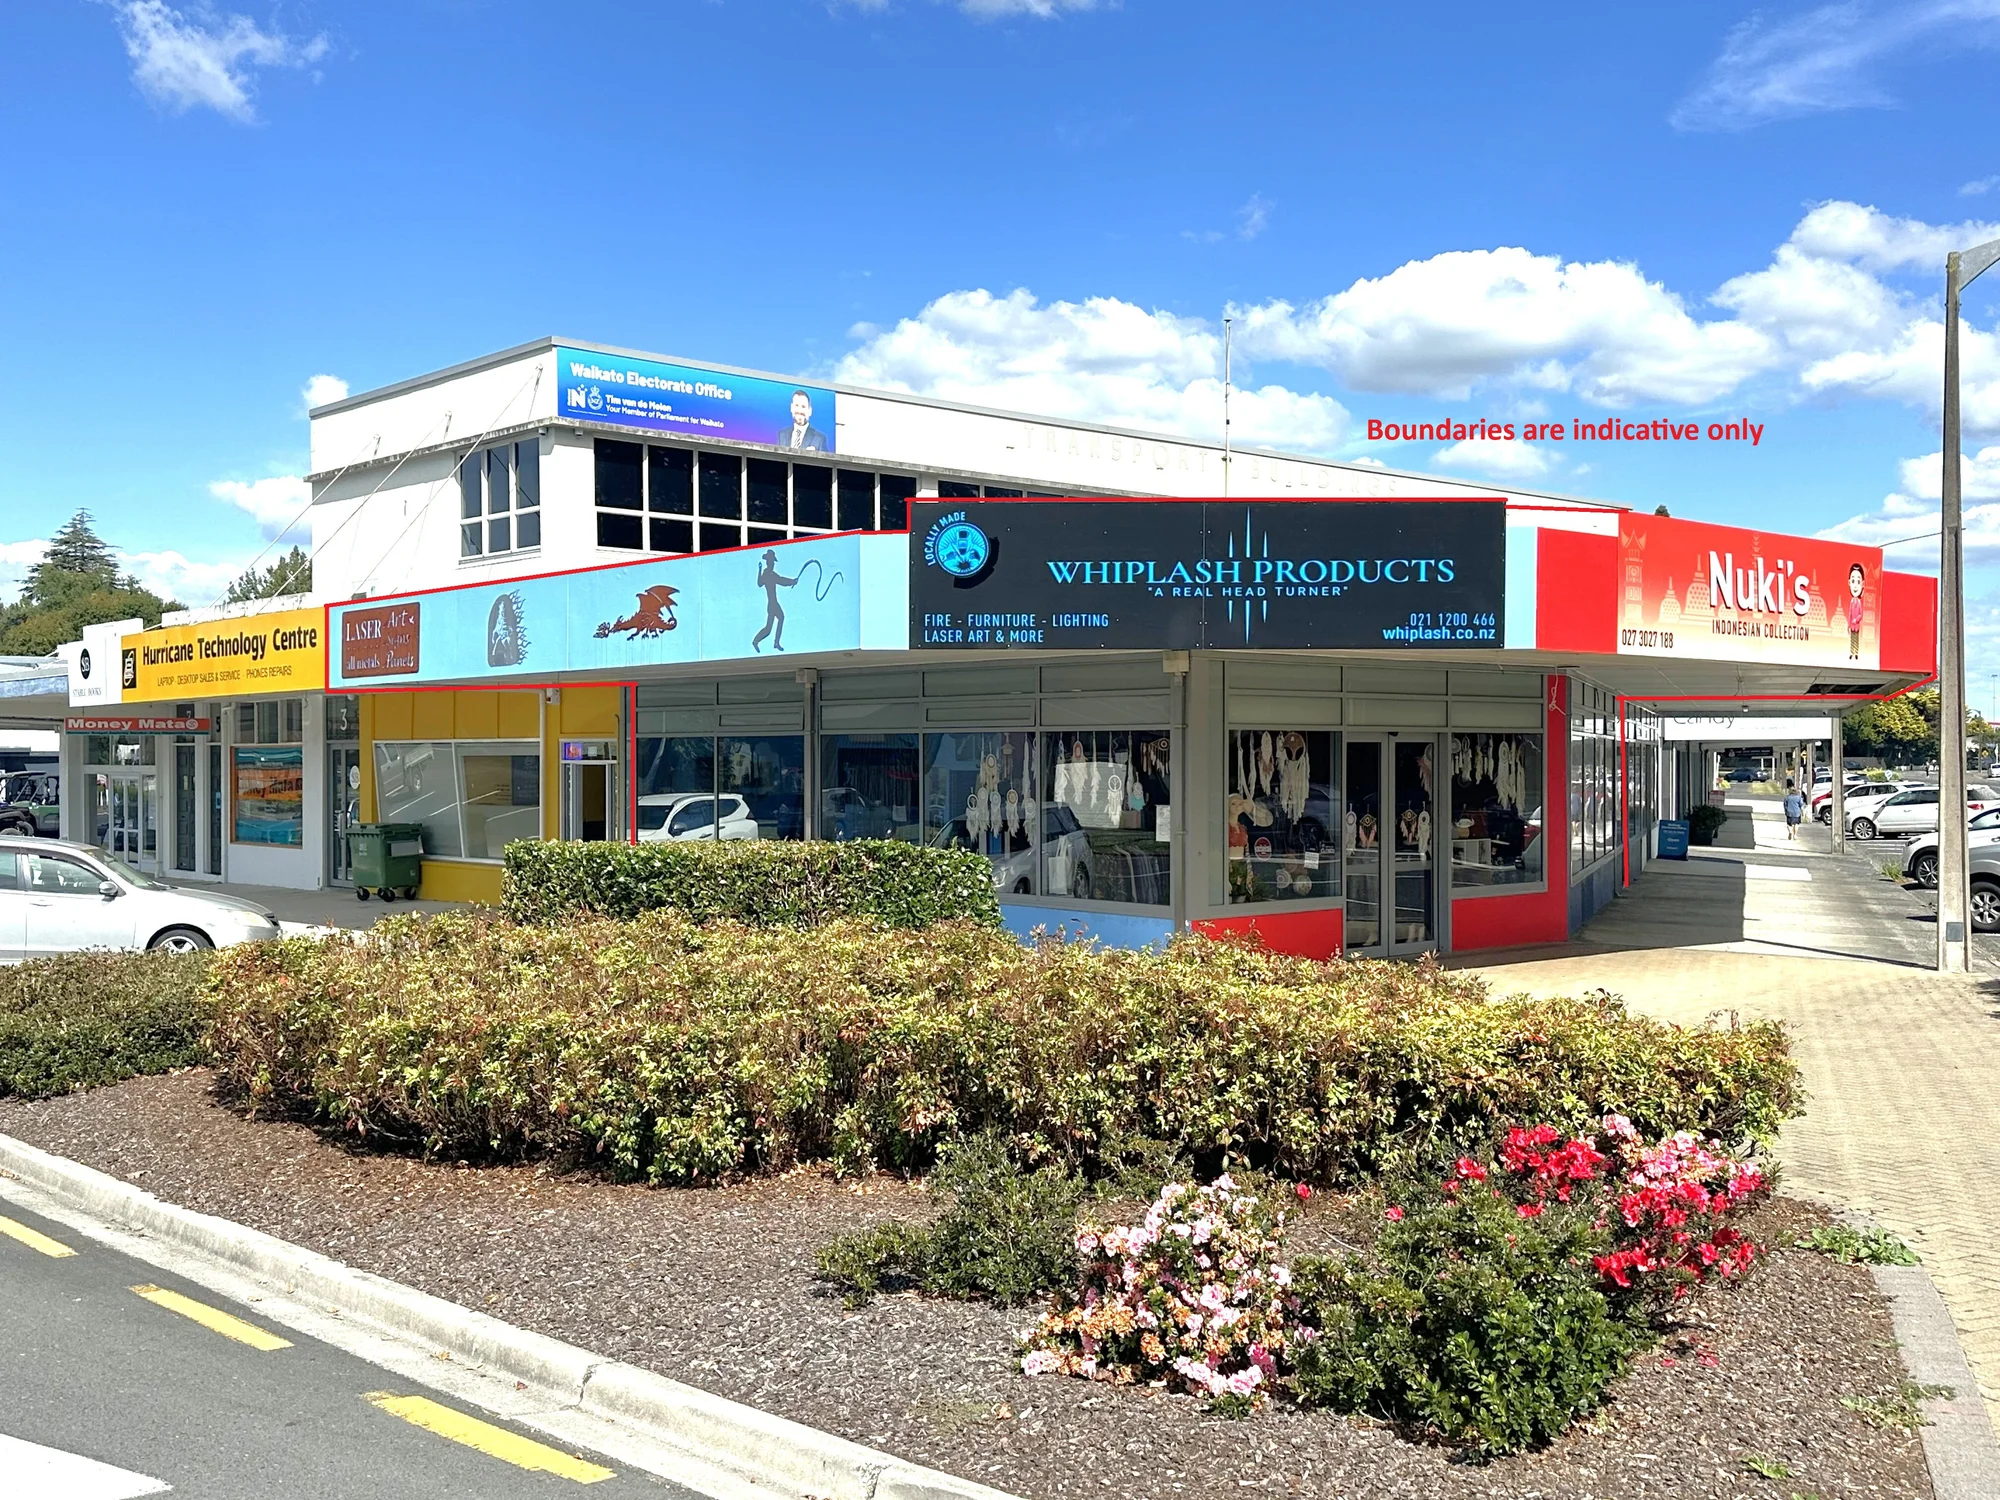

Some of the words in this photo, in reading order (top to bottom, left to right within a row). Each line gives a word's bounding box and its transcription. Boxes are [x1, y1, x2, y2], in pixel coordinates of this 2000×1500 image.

[569, 361, 625, 384] Waikato
[626, 370, 694, 394] Electorate
[695, 381, 732, 400] Office
[605, 394, 621, 405] Tim
[622, 398, 637, 407] van
[605, 404, 621, 413] Your
[622, 406, 647, 418] Member
[656, 411, 689, 424] Parliament
[690, 416, 699, 425] for
[924, 523, 940, 566] LOCALLY
[938, 511, 966, 527] MADE
[1046, 559, 1242, 584] WHIPLASH
[1253, 559, 1454, 584] PRODUCTS
[1173, 586, 1213, 597] REAL
[1222, 586, 1266, 597] HEAD
[1708, 550, 1811, 617] Nuki's
[346, 619, 382, 642] LASER
[387, 609, 409, 628] Art
[924, 613, 951, 627] FIRE
[967, 613, 1036, 627] FURNITURE
[1052, 613, 1109, 627] LIGHTING
[1410, 612, 1431, 626] 021
[1438, 612, 1468, 626] 1200
[1473, 612, 1496, 626] 466
[924, 629, 963, 643] LASER
[967, 629, 990, 643] ART
[995, 629, 1005, 643] &
[1010, 629, 1044, 643] MORE
[1382, 626, 1496, 642] whiplash.co.nz
[1621, 628, 1637, 646] 027
[1638, 629, 1657, 647] 3027
[1659, 631, 1674, 649] 188
[1712, 619, 1761, 638] INDONESIAN
[1764, 623, 1810, 641] COLLECTION
[142, 639, 194, 666] Hurricane
[197, 631, 267, 661] Technology
[272, 626, 317, 651] Centre
[157, 675, 175, 687] LAPTOP
[177, 673, 199, 685] DESKTOP
[199, 672, 215, 683] SALES
[219, 669, 241, 681] SERVICE
[246, 667, 268, 679] PHONES
[268, 665, 292, 677] REPAIRS
[67, 718, 133, 731] Money
[340, 708, 348, 731] 3
